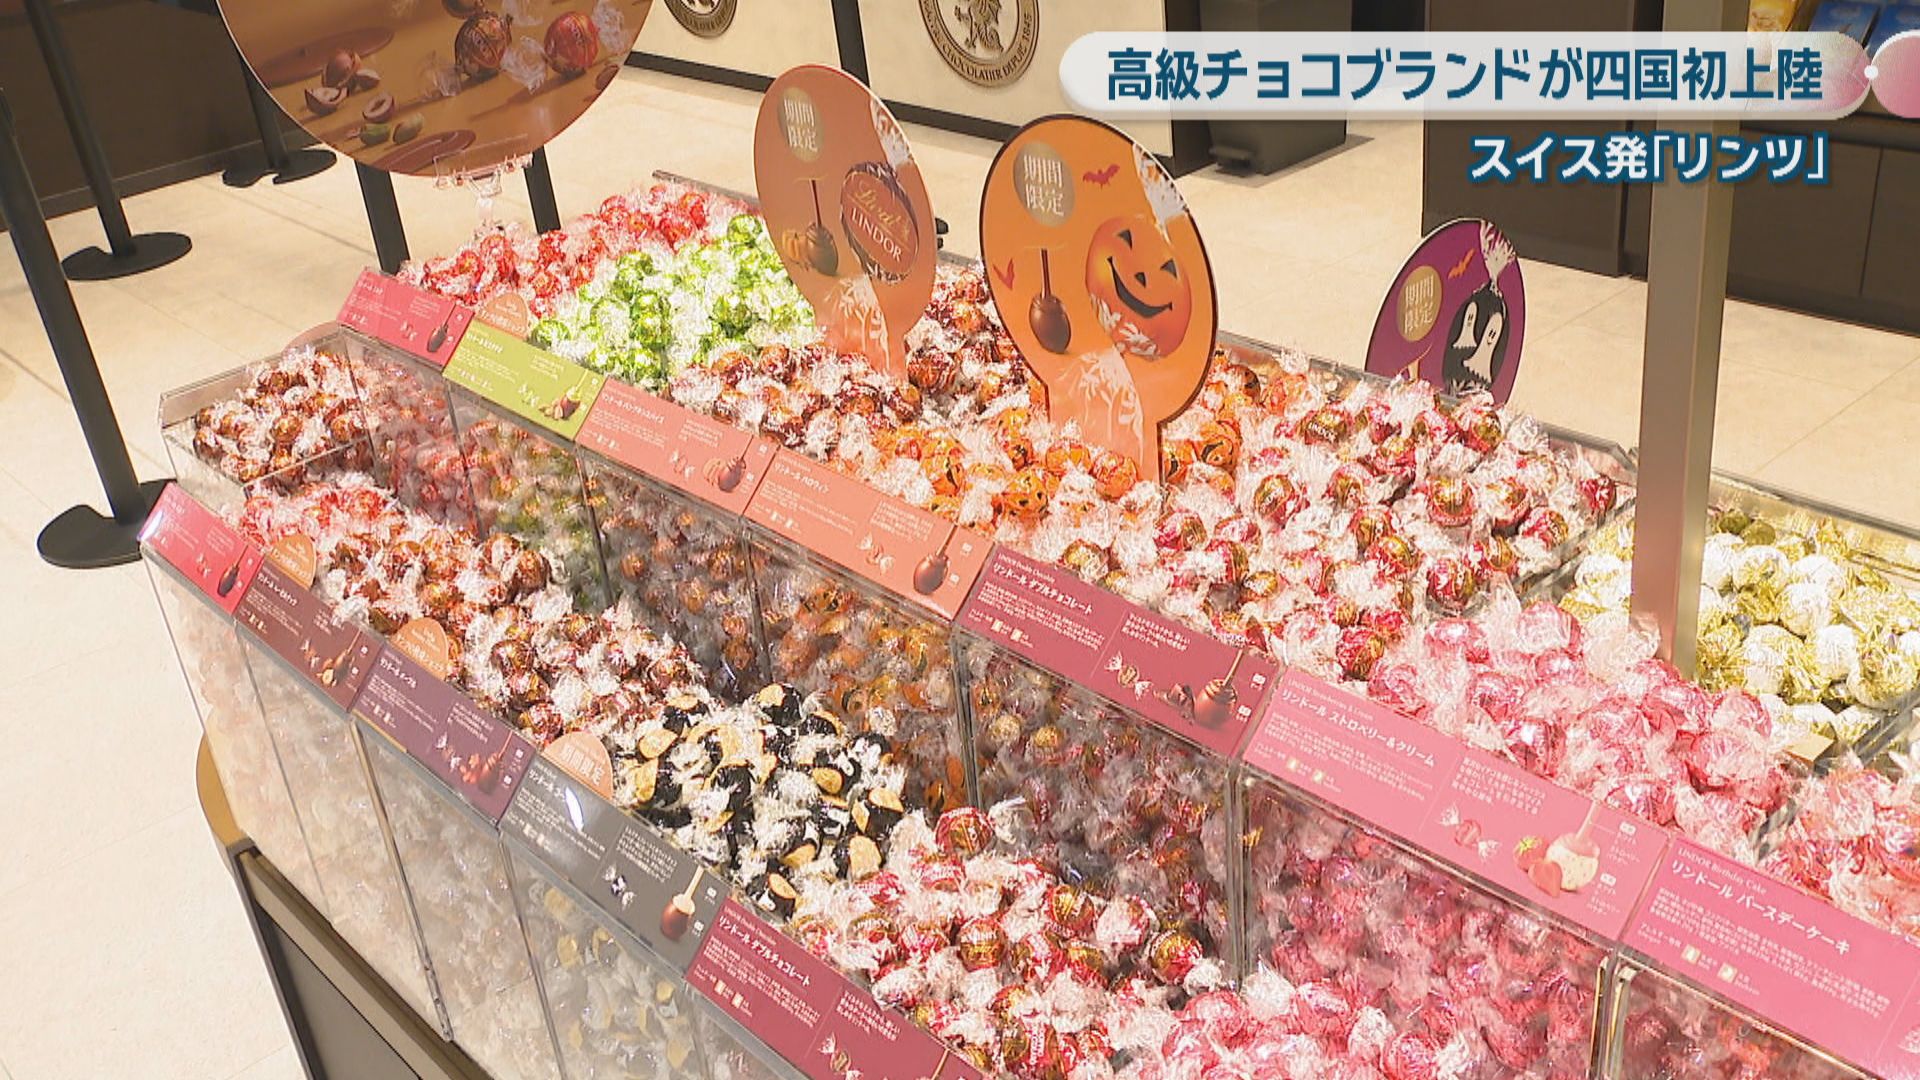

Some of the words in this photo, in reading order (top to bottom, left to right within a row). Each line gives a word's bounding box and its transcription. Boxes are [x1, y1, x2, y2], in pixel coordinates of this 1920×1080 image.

[1023, 154, 1063, 188] 期間
[1025, 183, 1064, 217] 限定
[851, 207, 903, 263] LINDOR
[1307, 421, 1339, 442] LINDOR
[991, 562, 1028, 586] リンドール
[1027, 577, 1094, 616] ダブルチョコレート
[1279, 688, 1328, 718] リンドール
[1676, 846, 1713, 870] LINDOR
[1709, 862, 1746, 886] Birthday
[1667, 860, 1735, 900] リンドール
[1734, 891, 1853, 957] バースデーケーキ
[717, 914, 751, 946] リンドール
[750, 937, 812, 989] ダブルチョコレート
